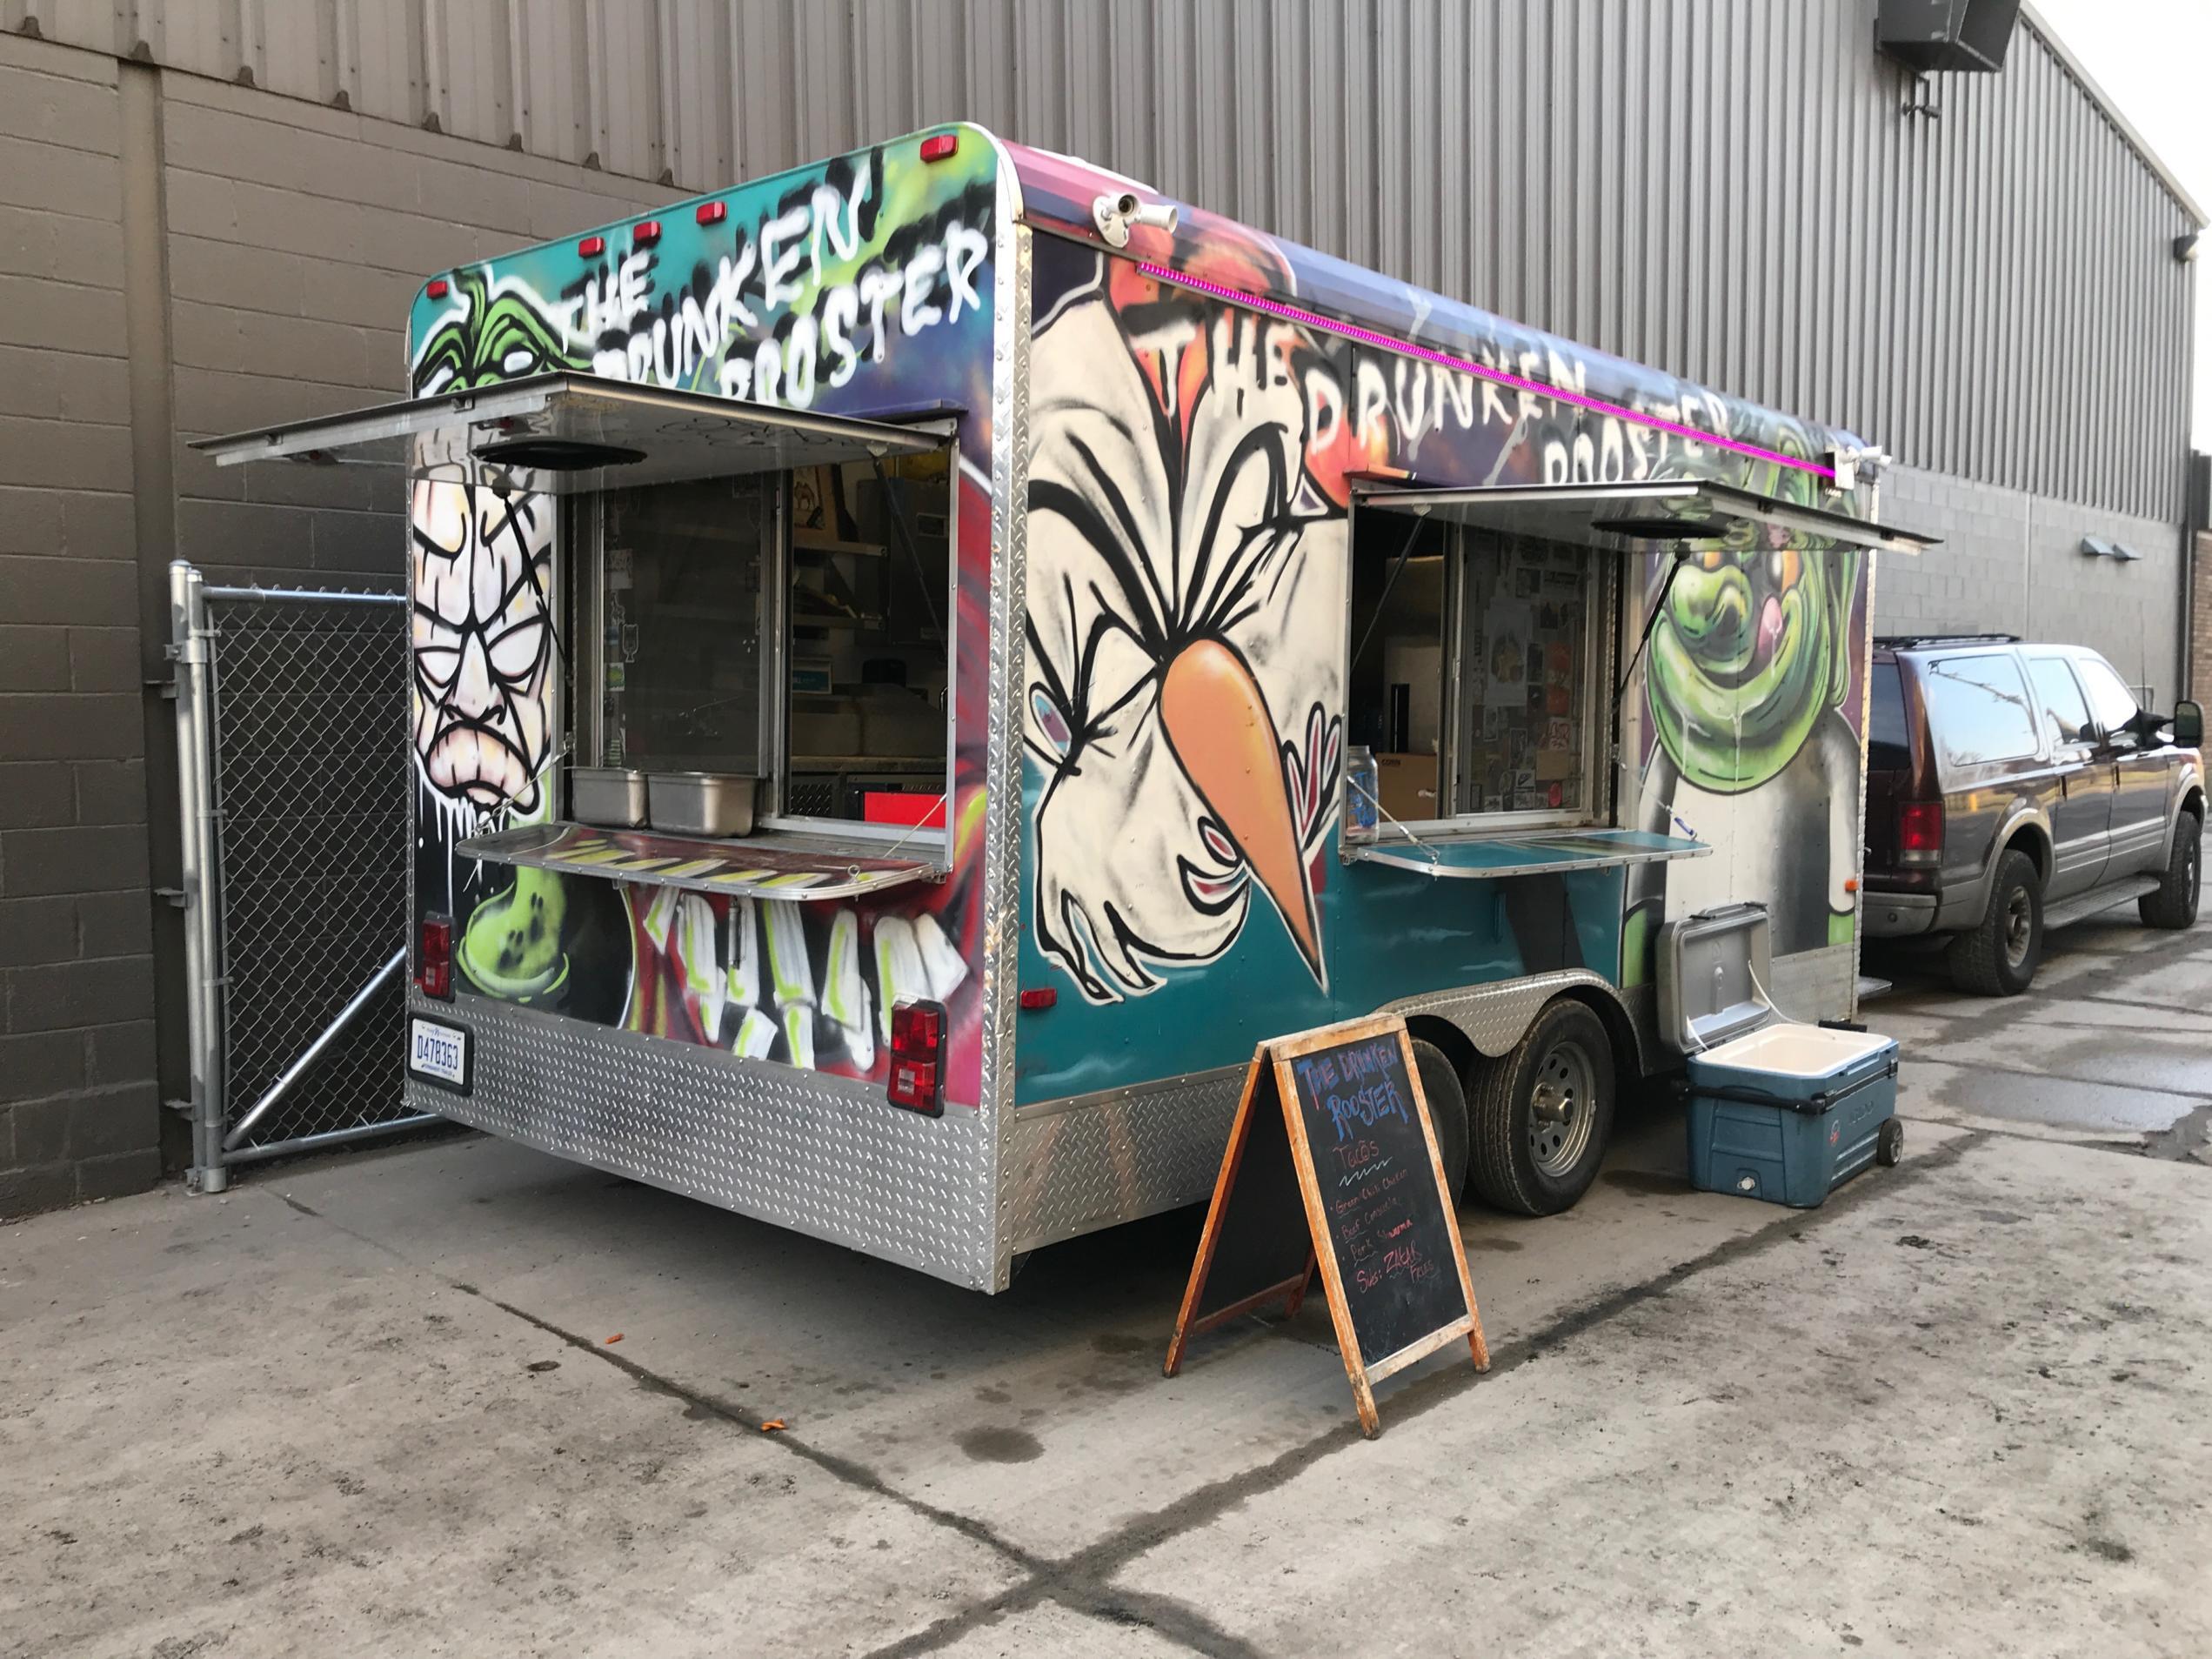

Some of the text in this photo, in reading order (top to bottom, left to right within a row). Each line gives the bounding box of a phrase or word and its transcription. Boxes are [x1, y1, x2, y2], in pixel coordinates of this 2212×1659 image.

[548, 249, 650, 354] THE
[1130, 315, 1586, 456] THE DRUNKEN
[1545, 390, 1730, 484] ROOSTER
[418, 1035, 458, 1070] D478363
[1327, 1080, 1408, 1141] ROOSTER
[1351, 1239, 1373, 1261] Pork
